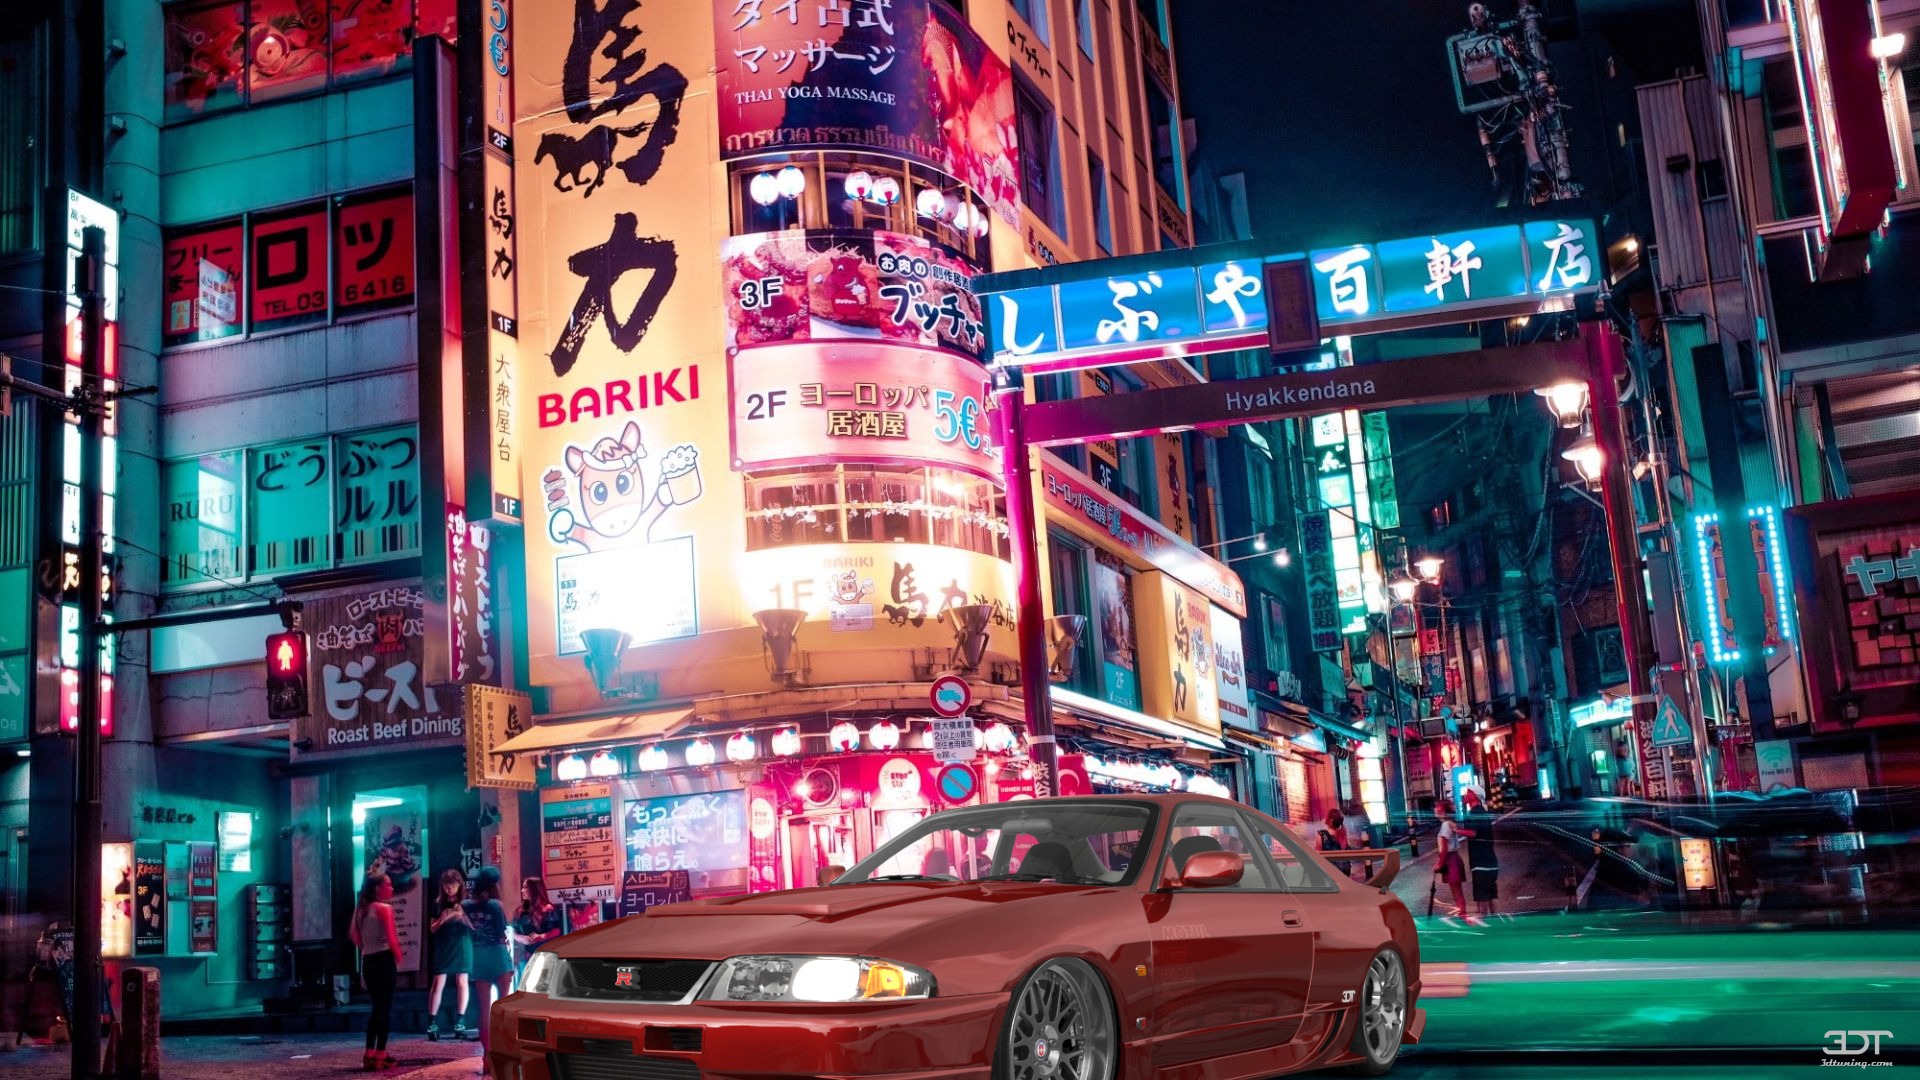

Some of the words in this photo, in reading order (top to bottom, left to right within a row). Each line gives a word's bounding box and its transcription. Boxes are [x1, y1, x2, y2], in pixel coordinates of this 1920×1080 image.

[734, 37, 896, 76] マッサージ
[735, 88, 774, 105] THAI
[778, 86, 823, 99] YOGA
[827, 86, 896, 106] MASSAGE
[492, 132, 508, 149] 2F
[489, 185, 514, 280] 馬力
[165, 244, 233, 272] フリー
[878, 252, 928, 279] お肉の
[297, 292, 325, 310] 03
[345, 276, 405, 301] 6416
[740, 277, 783, 309] 3F
[998, 223, 1591, 355] しぶや百軒店
[498, 317, 512, 333] 1F
[495, 353, 512, 462] 大衆屋台
[538, 364, 700, 429] BARIKI
[1225, 380, 1376, 411] Hyakkendana
[746, 390, 787, 420] 2F
[800, 383, 929, 407] ヨーロッパ
[934, 390, 981, 449] 5€
[827, 411, 907, 438] 居酒屋
[256, 436, 417, 491] どうぶつ
[1099, 464, 1111, 488] 3F
[171, 494, 234, 522] RURU
[338, 479, 419, 527] ルル
[502, 498, 516, 516] 1F
[470, 525, 495, 681] ローストビーフ
[317, 622, 376, 650] 油そば
[1174, 590, 1189, 712] 馬力
[1116, 671, 1125, 689] 2F
[328, 725, 369, 745] Roast
[373, 720, 409, 739] Beef
[411, 716, 461, 736] Dining
[1761, 768, 1776, 776] Free
[598, 816, 610, 825] 5F
[137, 886, 149, 896] 3F
